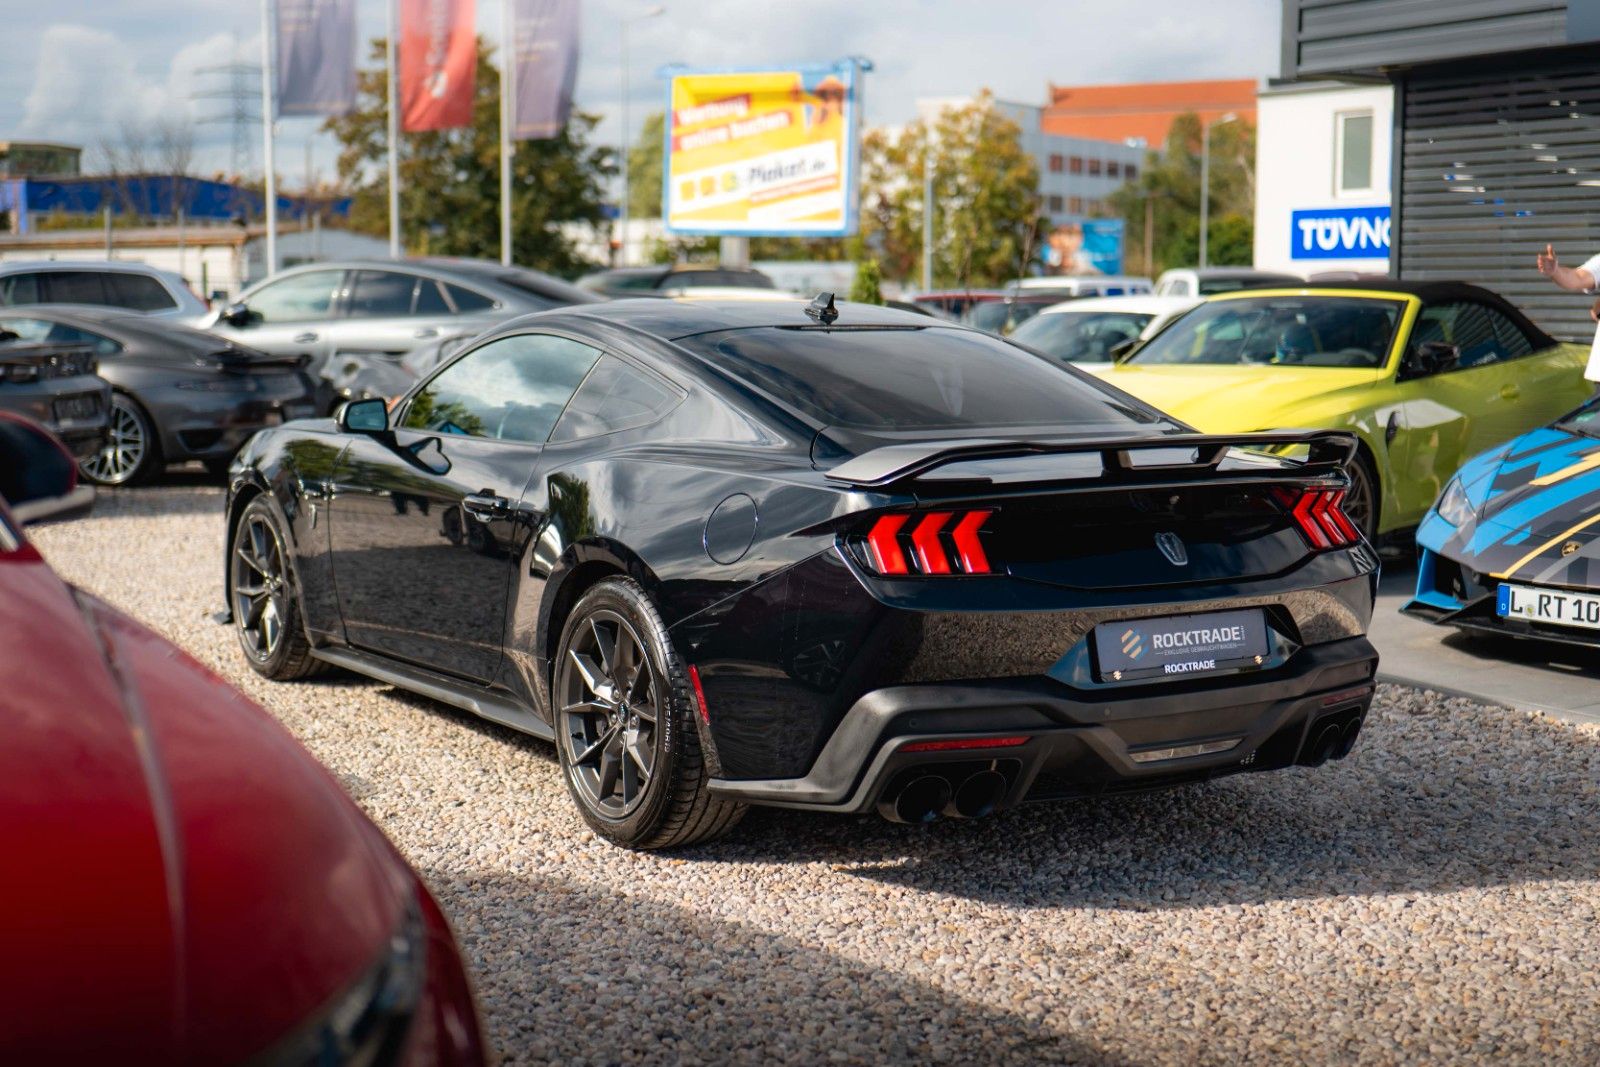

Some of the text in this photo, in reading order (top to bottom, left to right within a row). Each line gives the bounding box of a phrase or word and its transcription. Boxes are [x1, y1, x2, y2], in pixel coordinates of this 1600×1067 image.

[1511, 591, 1522, 613] L
[1538, 594, 1567, 618] RT
[1153, 627, 1240, 649] ROCKTRADE
[1164, 660, 1215, 673] ROCKTRADE
